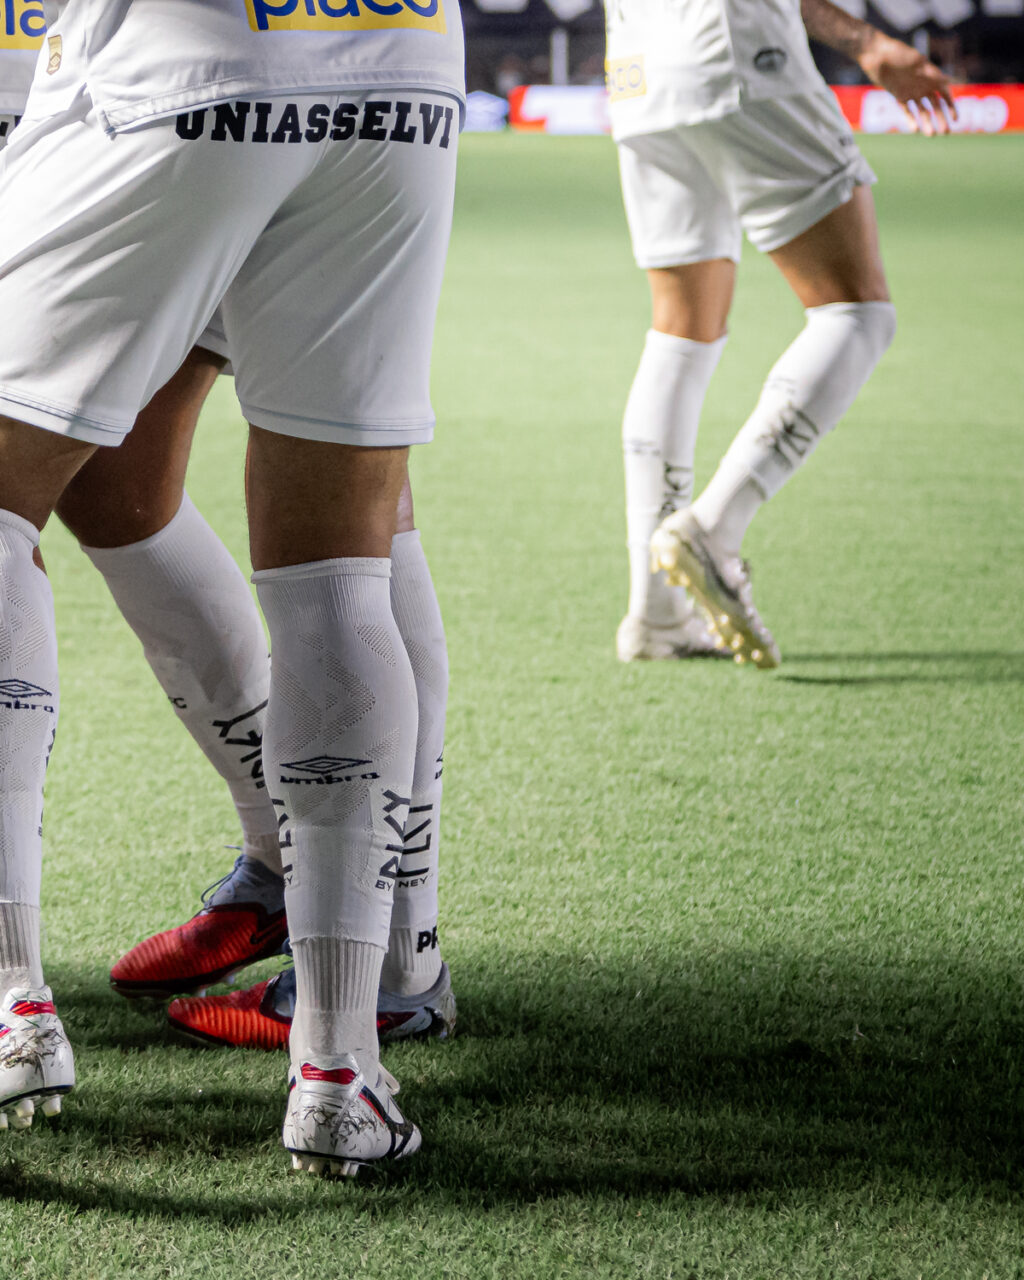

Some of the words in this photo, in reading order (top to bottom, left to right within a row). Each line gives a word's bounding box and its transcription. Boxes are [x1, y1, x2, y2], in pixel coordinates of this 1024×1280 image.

[175, 100, 454, 150] UNIASSELVI
[279, 772, 381, 785] umbro
[398, 876, 428, 889] NEY
